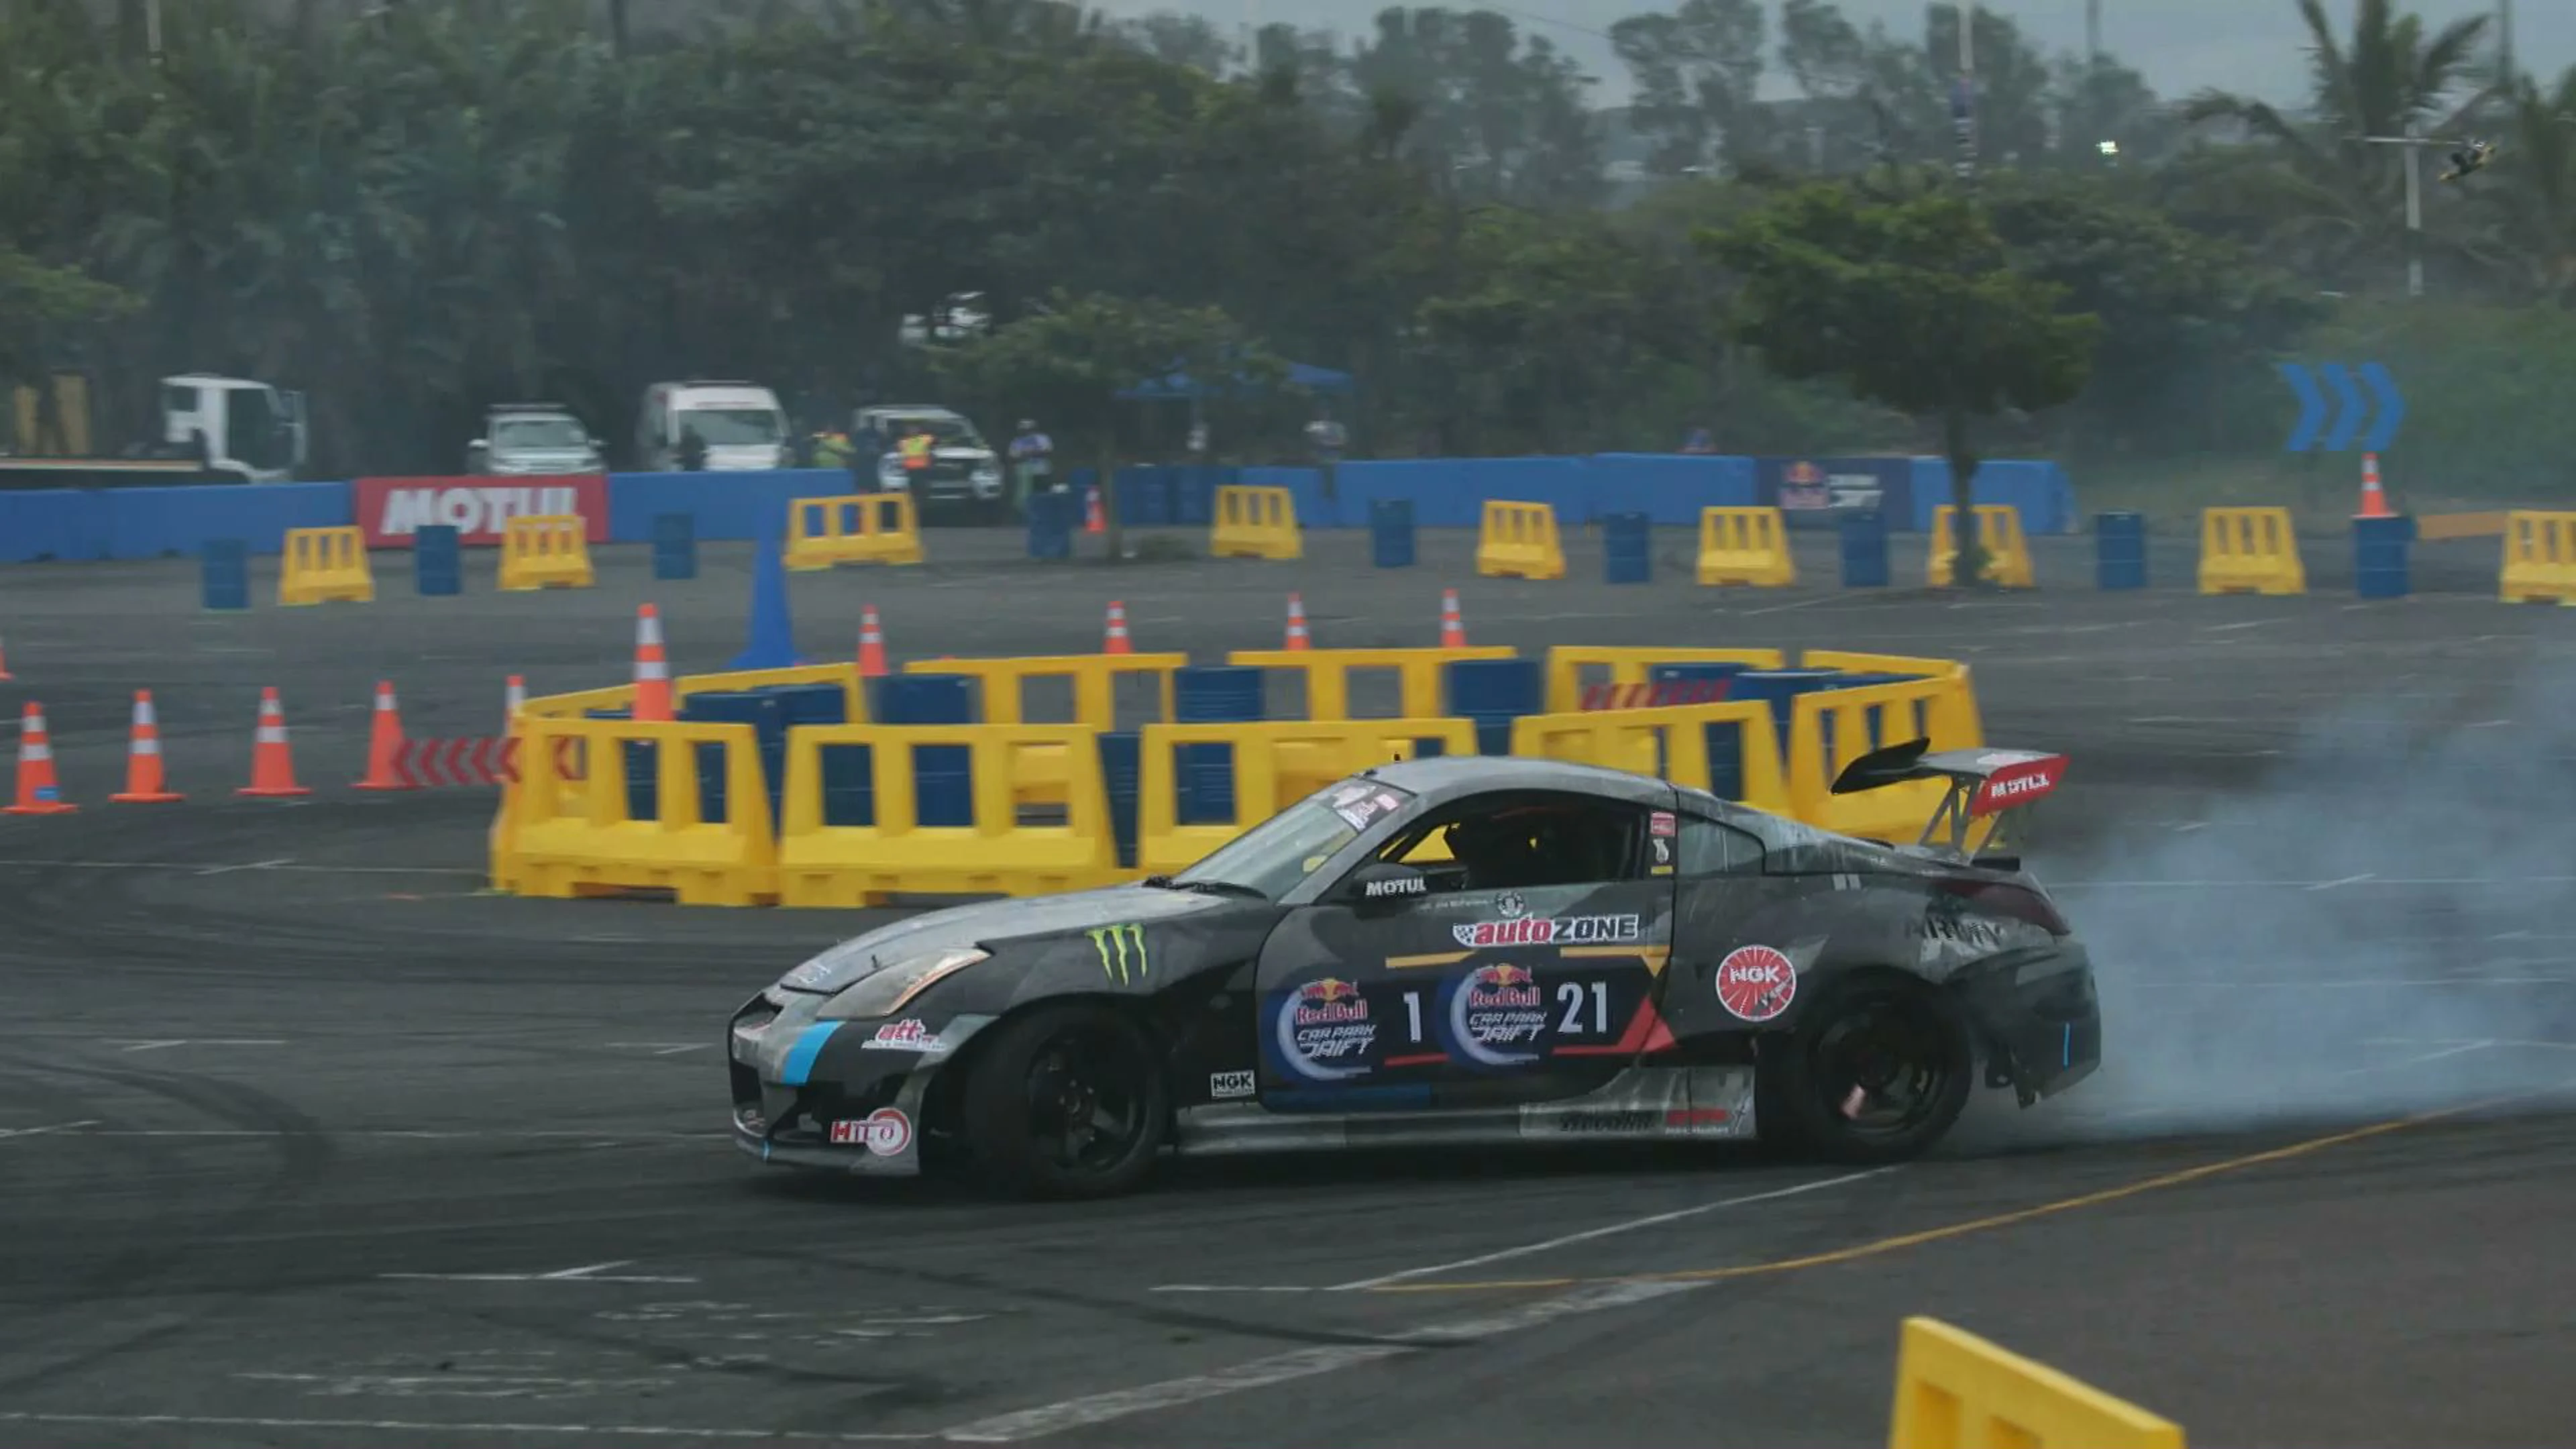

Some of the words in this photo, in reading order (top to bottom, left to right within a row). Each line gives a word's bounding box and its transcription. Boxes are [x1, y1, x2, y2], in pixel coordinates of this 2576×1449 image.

[1365, 876, 1427, 896] MOTUL
[1730, 965, 1780, 985] NGK
[1470, 987, 1505, 1008] Red
[1505, 986, 1541, 1007] Bull
[1557, 981, 1607, 1034] 21
[1296, 1003, 1332, 1025] Red
[1332, 998, 1368, 1021] Bull
[1403, 991, 1421, 1042] 1
[1297, 1027, 1331, 1040] CAR
[1332, 1024, 1377, 1040] PARK
[1213, 1073, 1252, 1089] NGK
